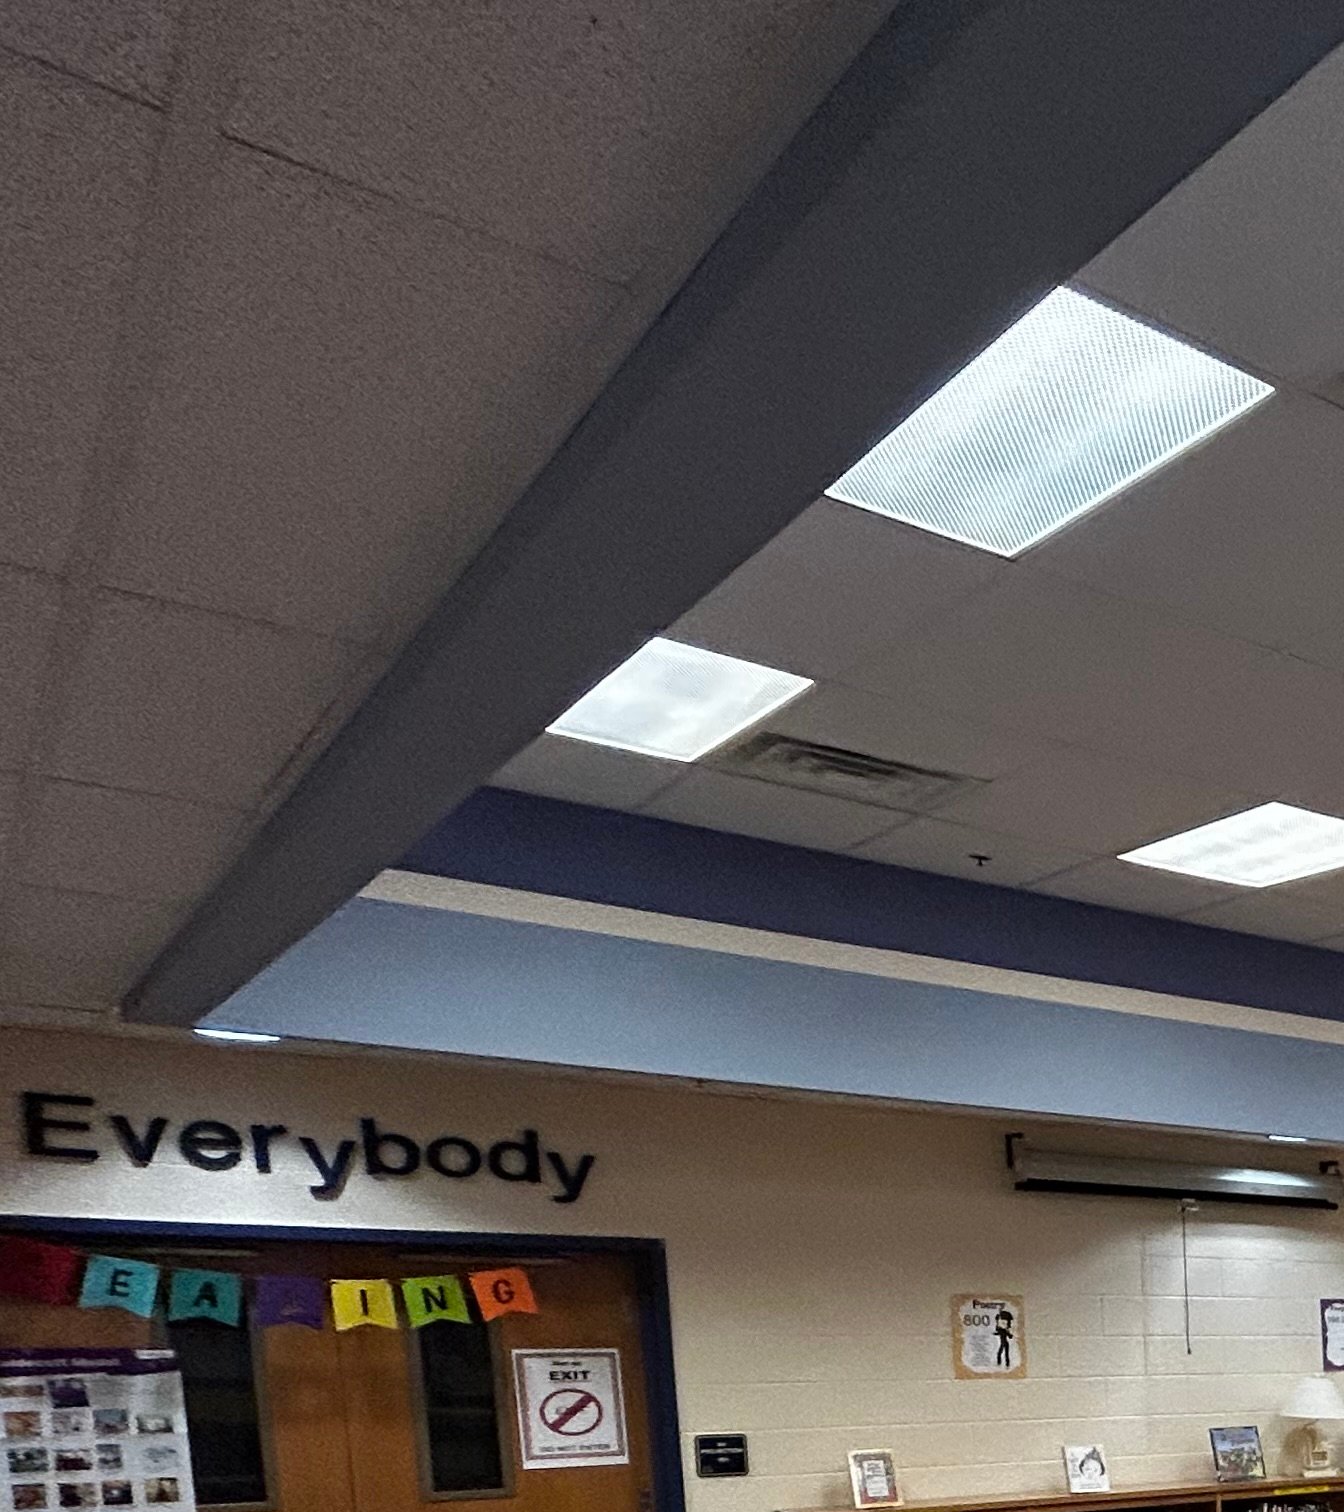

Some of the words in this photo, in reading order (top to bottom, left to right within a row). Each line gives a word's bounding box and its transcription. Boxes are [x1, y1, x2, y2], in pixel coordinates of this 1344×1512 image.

[19, 1091, 596, 1203] Everybody
[963, 1314, 990, 1327] 800
[549, 1370, 590, 1381] EXIT
